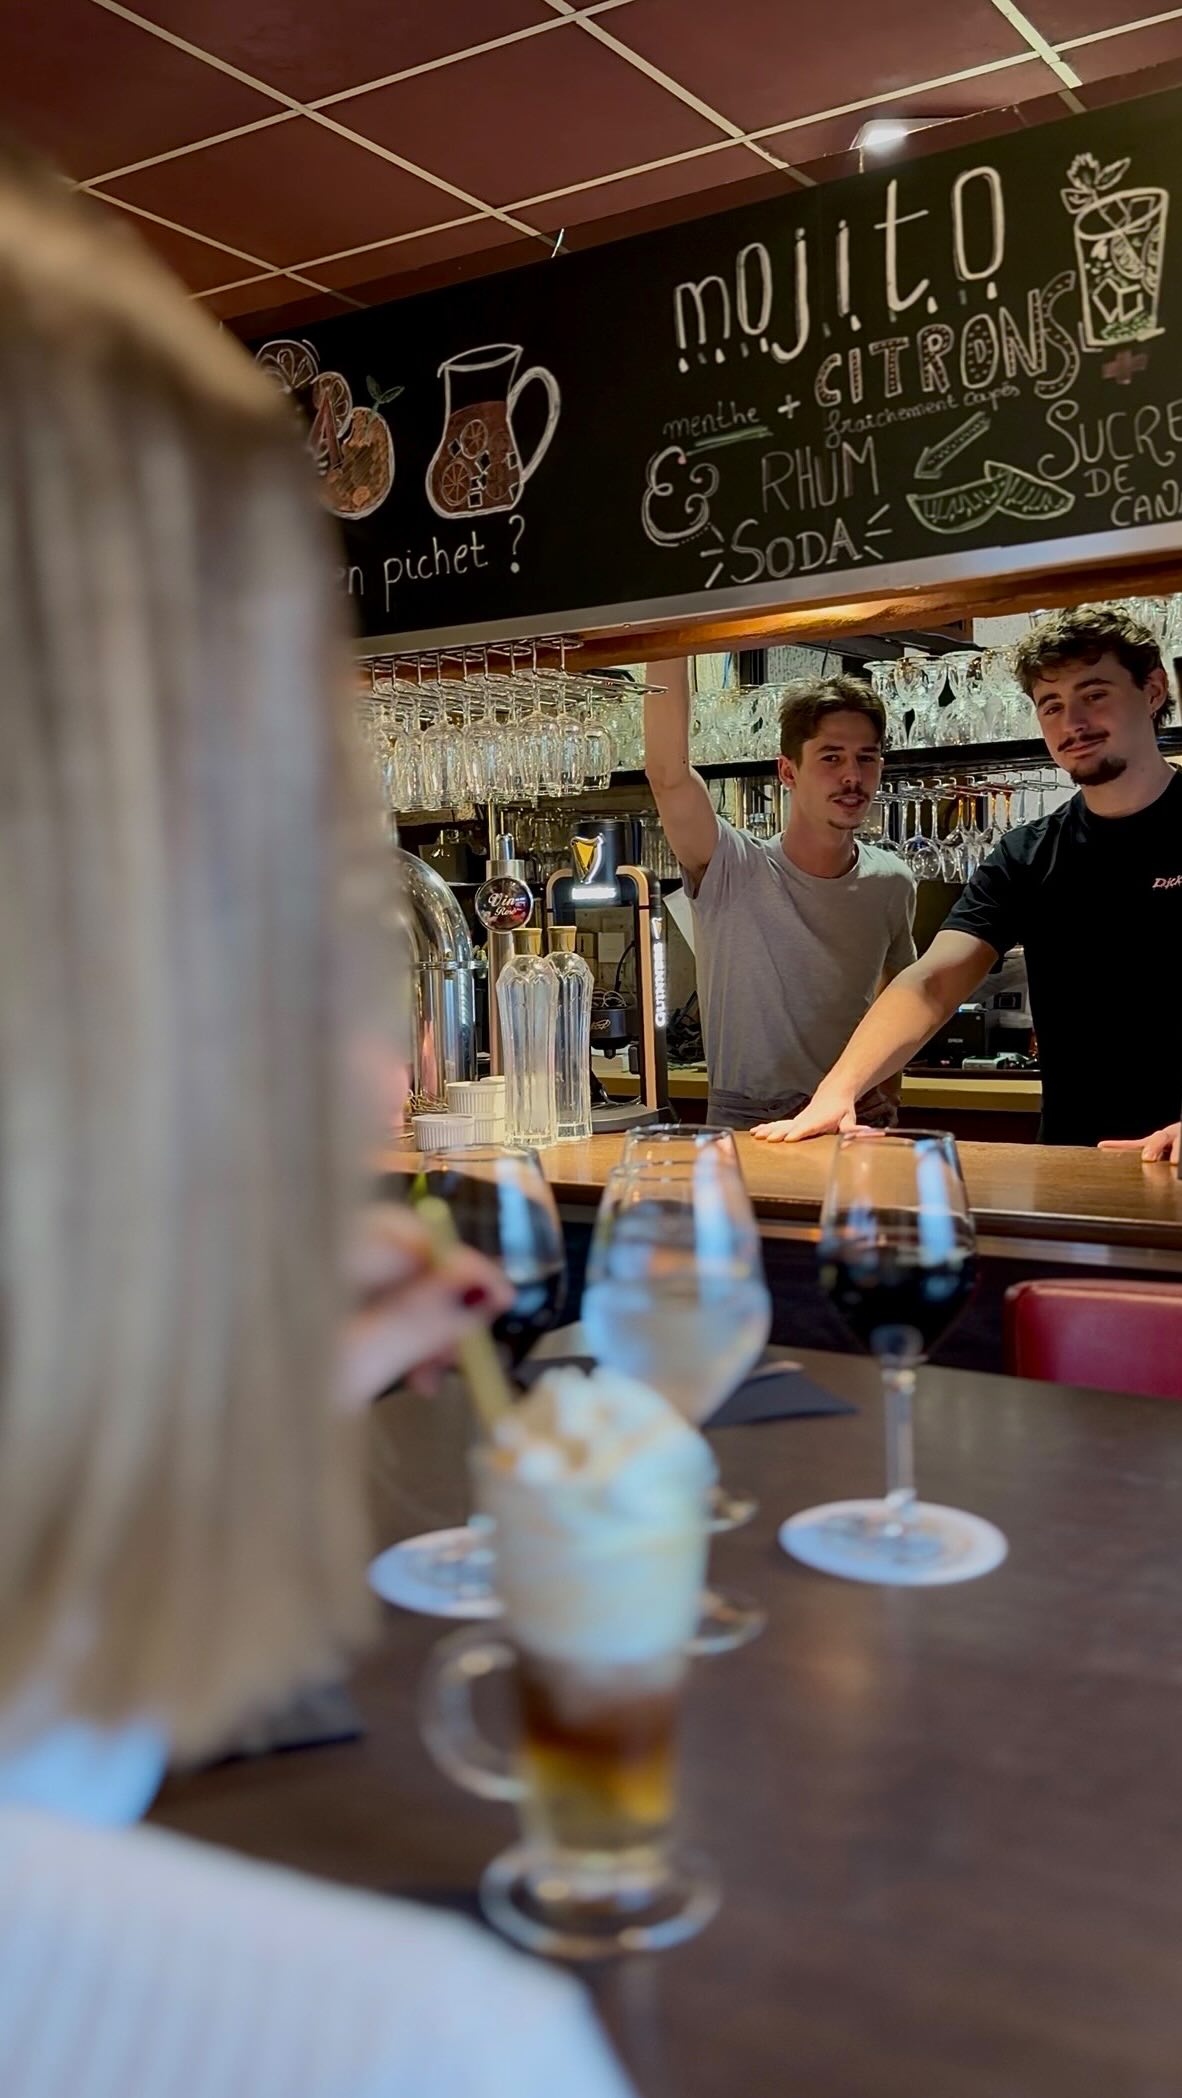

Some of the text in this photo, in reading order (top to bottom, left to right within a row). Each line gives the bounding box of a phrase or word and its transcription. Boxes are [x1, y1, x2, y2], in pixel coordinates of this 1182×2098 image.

[674, 166, 1005, 362] mojito
[662, 402, 760, 440] menthe
[815, 270, 1081, 407] CITRONS
[762, 436, 880, 514] RHUM
[1037, 399, 1182, 481] SUCRE
[1083, 463, 1136, 498] DE
[1111, 480, 1182, 526] CAN
[384, 531, 488, 612] pichet
[508, 514, 525, 573] ?
[730, 518, 865, 583] SODA
